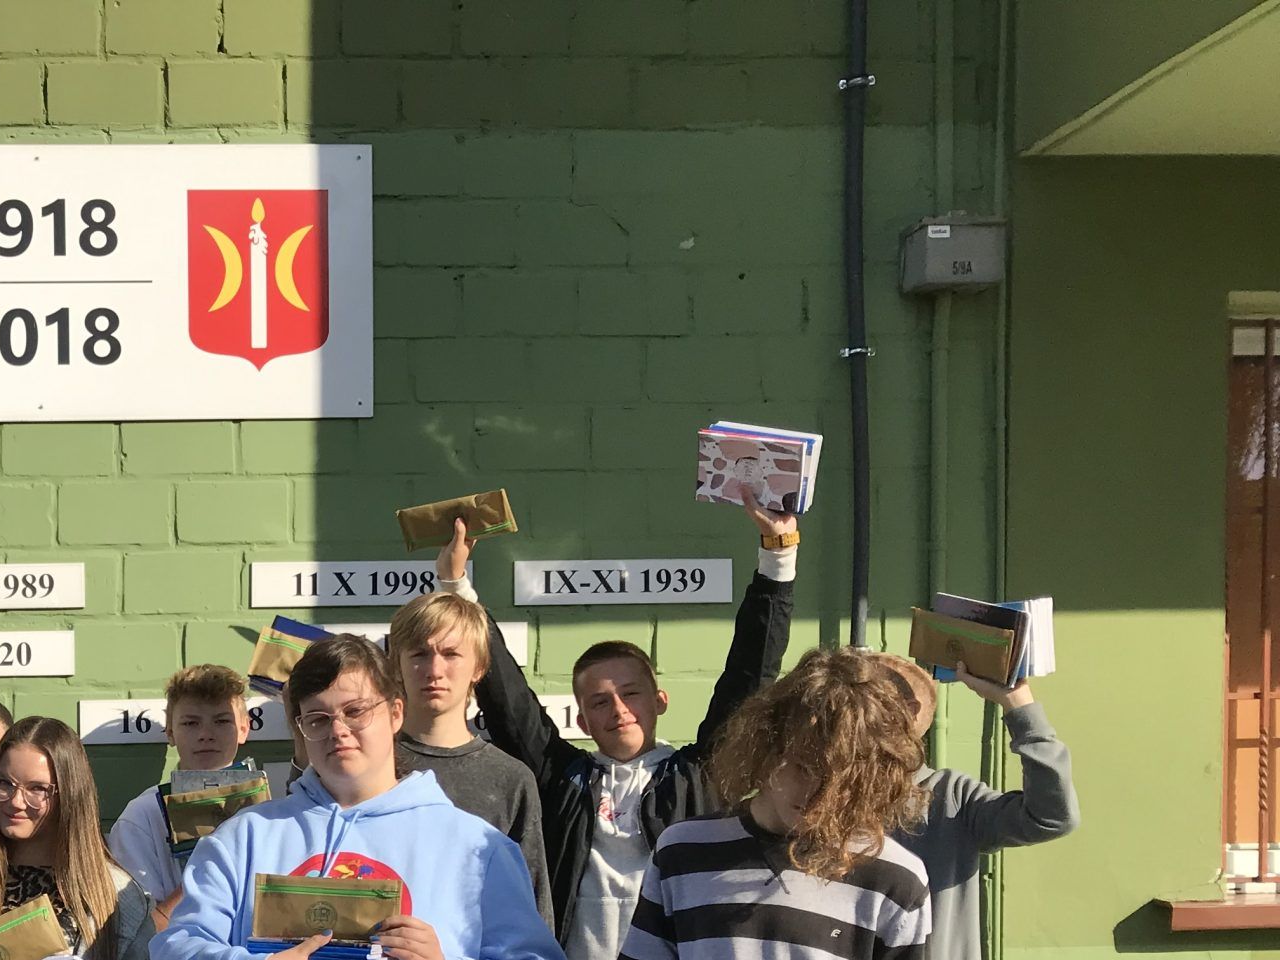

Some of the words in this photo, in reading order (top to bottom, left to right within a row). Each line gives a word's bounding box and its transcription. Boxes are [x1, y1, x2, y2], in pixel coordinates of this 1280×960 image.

[294, 571, 319, 596] 11
[332, 571, 358, 597] X
[369, 570, 435, 596] 1998
[543, 569, 629, 594] IX-XI
[640, 568, 706, 593] 1939
[119, 708, 152, 734] 16
